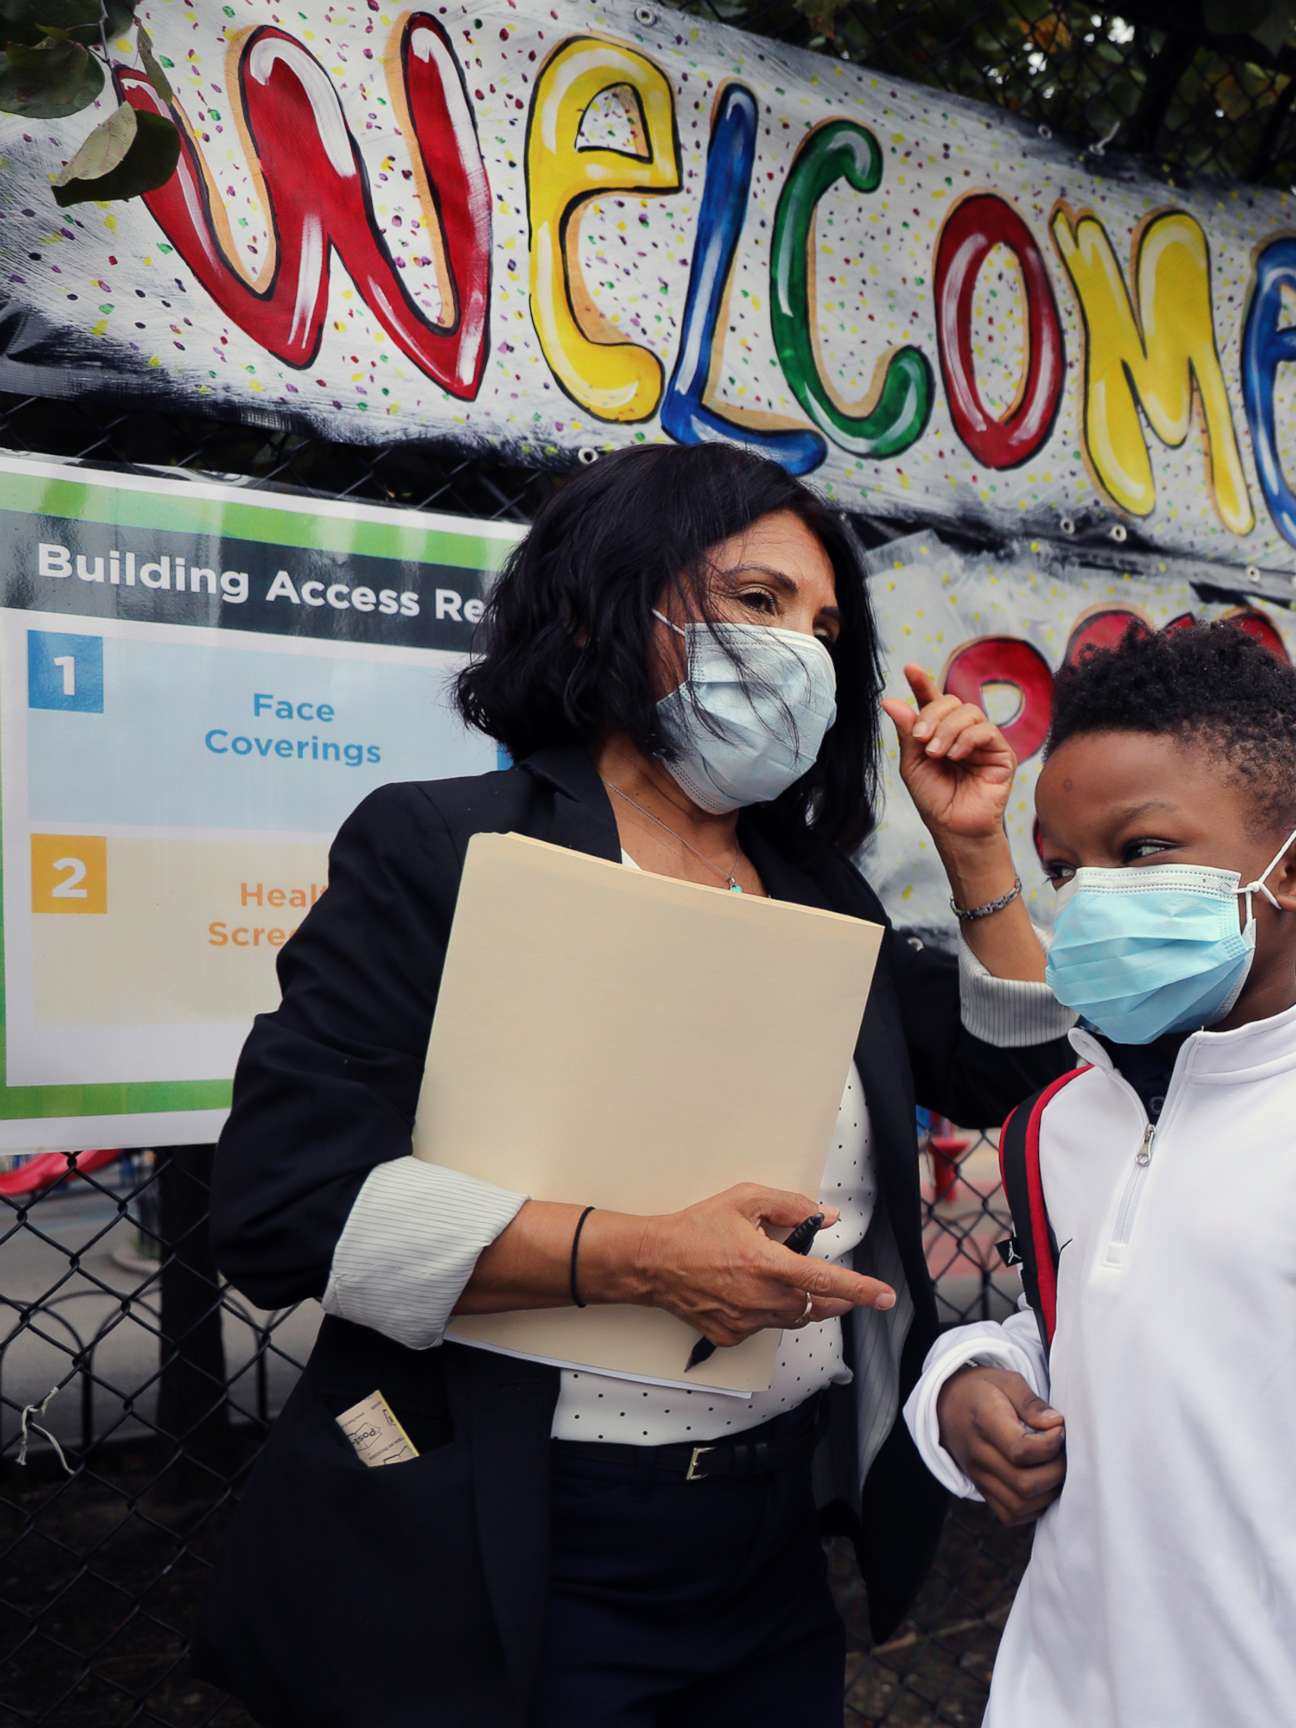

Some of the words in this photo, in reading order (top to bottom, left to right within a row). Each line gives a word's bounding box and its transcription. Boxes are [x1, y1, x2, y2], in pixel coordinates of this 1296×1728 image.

[37, 542, 250, 603] Building
[266, 569, 421, 618] Access
[53, 655, 77, 697] 1
[253, 692, 335, 723] Face
[204, 728, 382, 767] Coverings
[51, 857, 89, 899] 2
[239, 882, 328, 909] Heal
[207, 921, 298, 947] Scre
